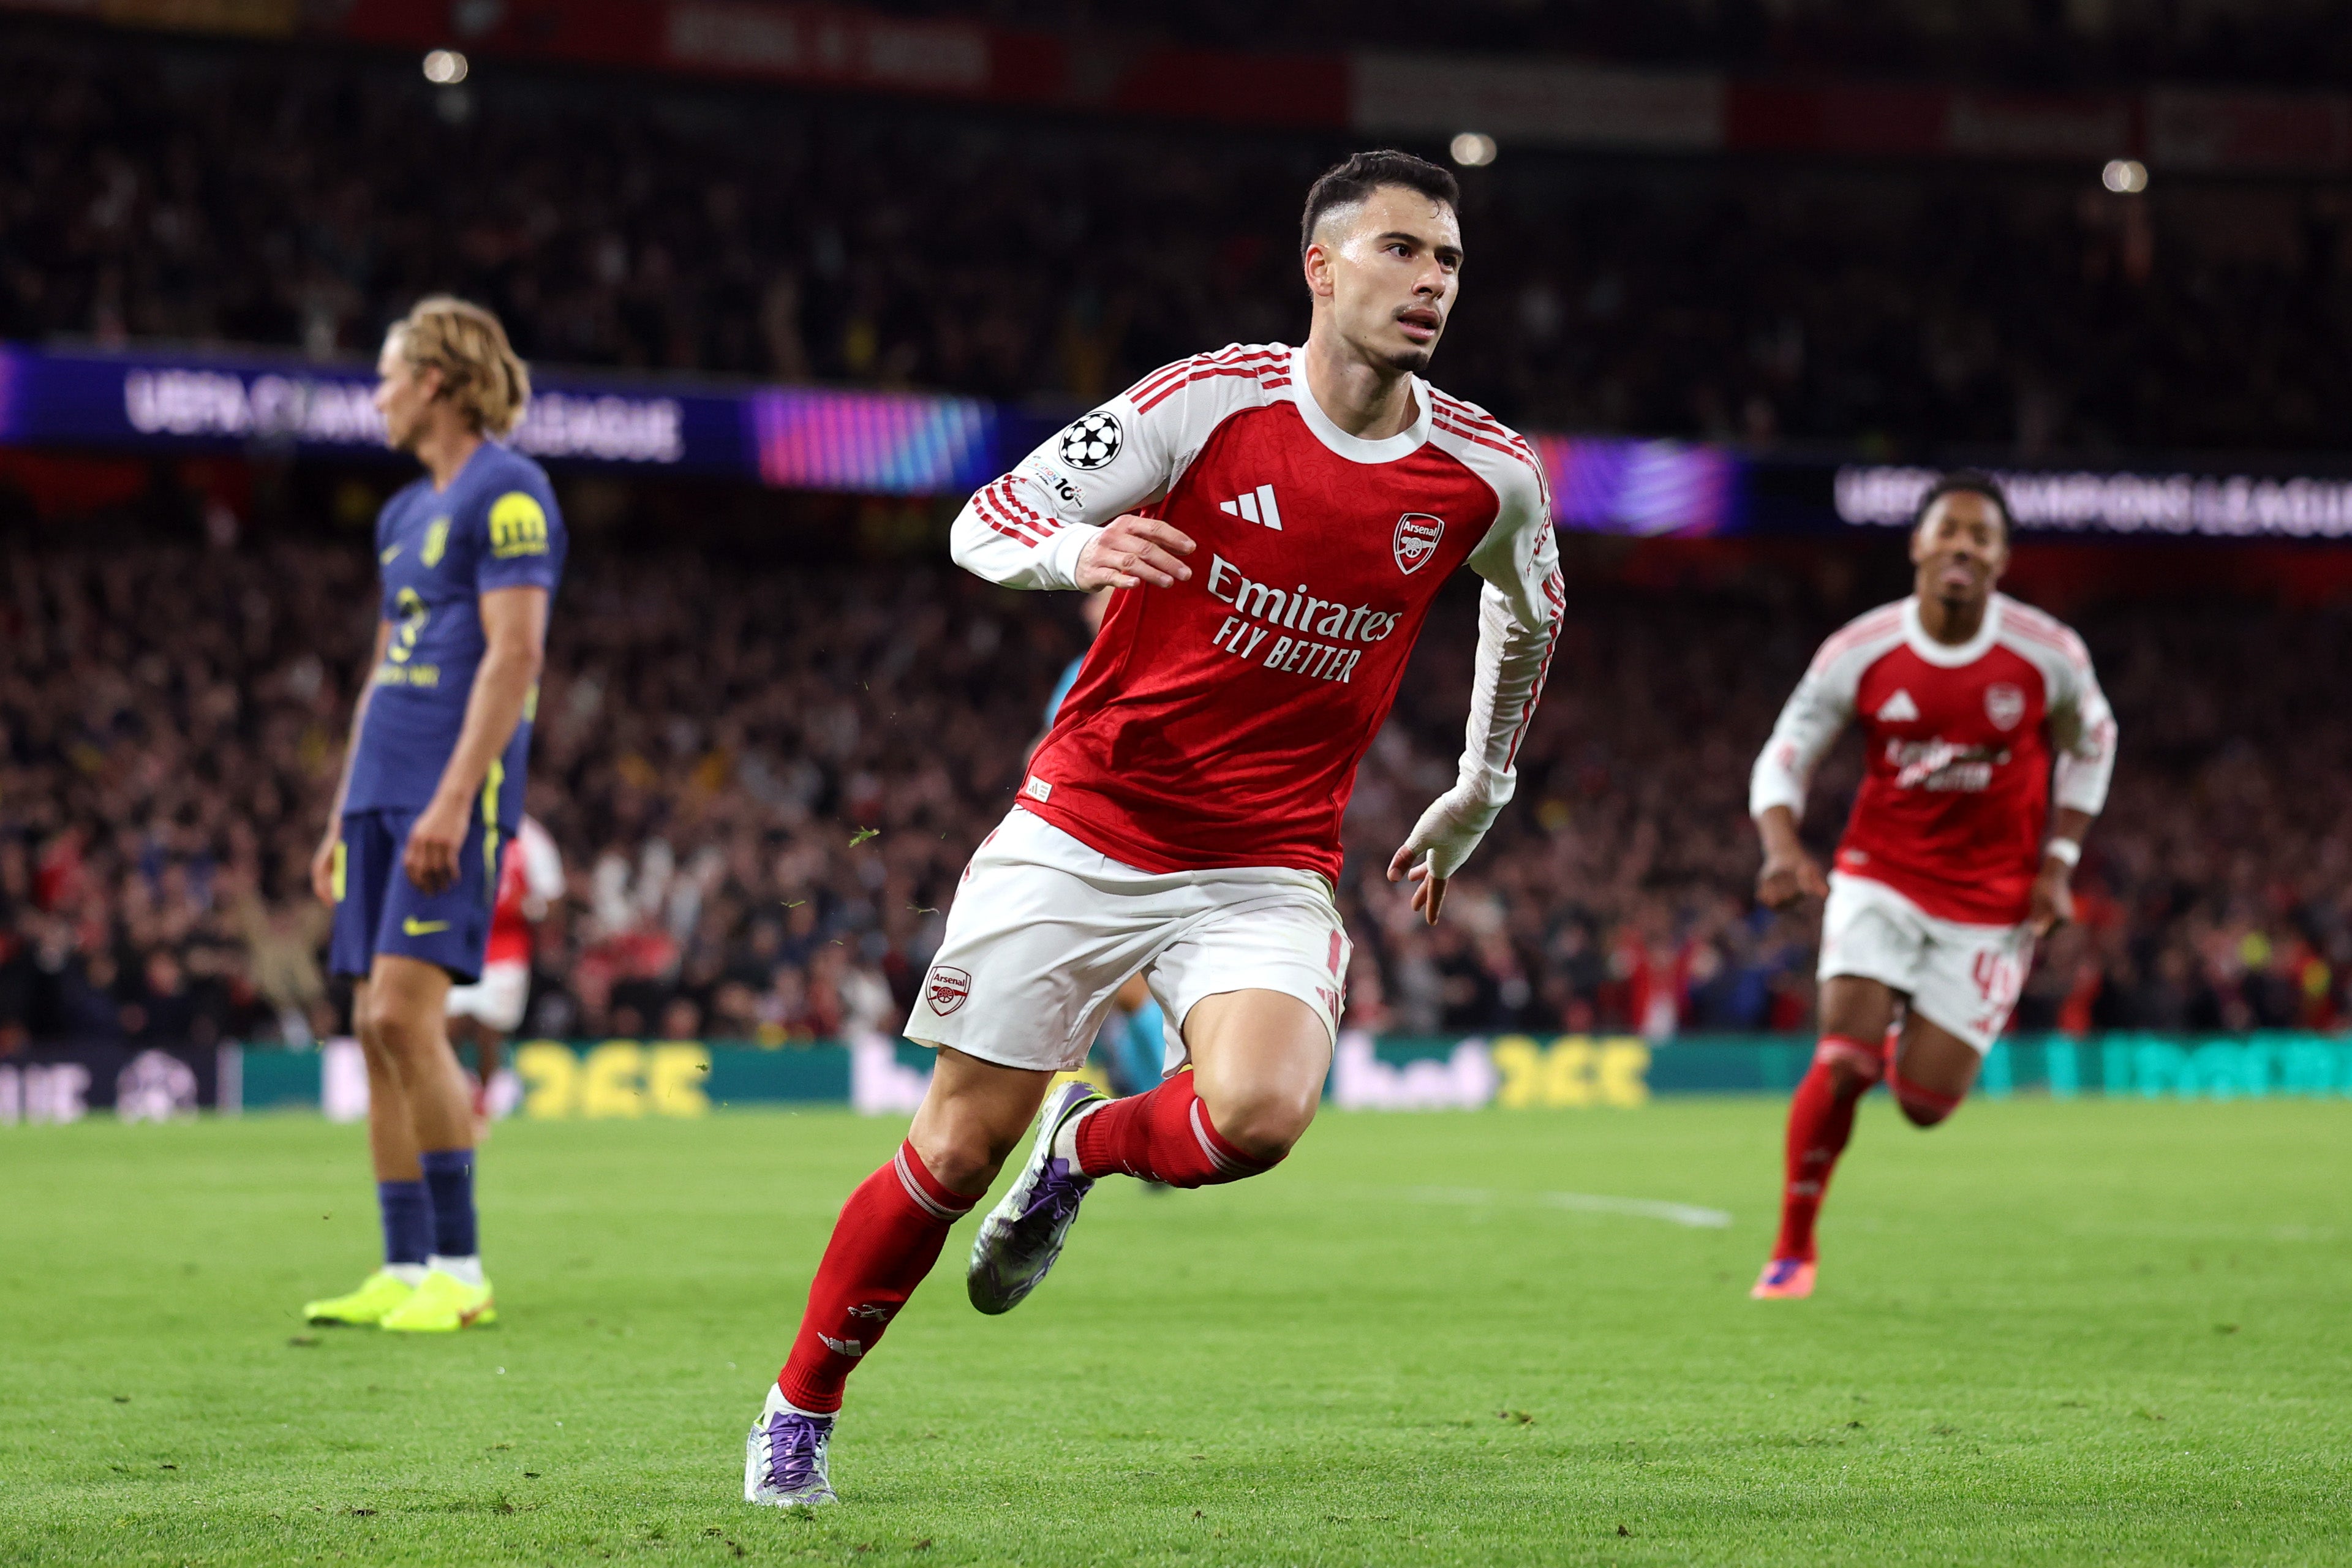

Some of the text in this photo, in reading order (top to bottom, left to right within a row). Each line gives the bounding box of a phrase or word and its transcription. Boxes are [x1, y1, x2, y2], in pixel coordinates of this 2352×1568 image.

[1403, 521, 1438, 537] Arsenal
[1207, 553, 1403, 642] Emirates
[1212, 616, 1361, 684] FLY BETTER
[933, 973, 965, 987] Arsenal
